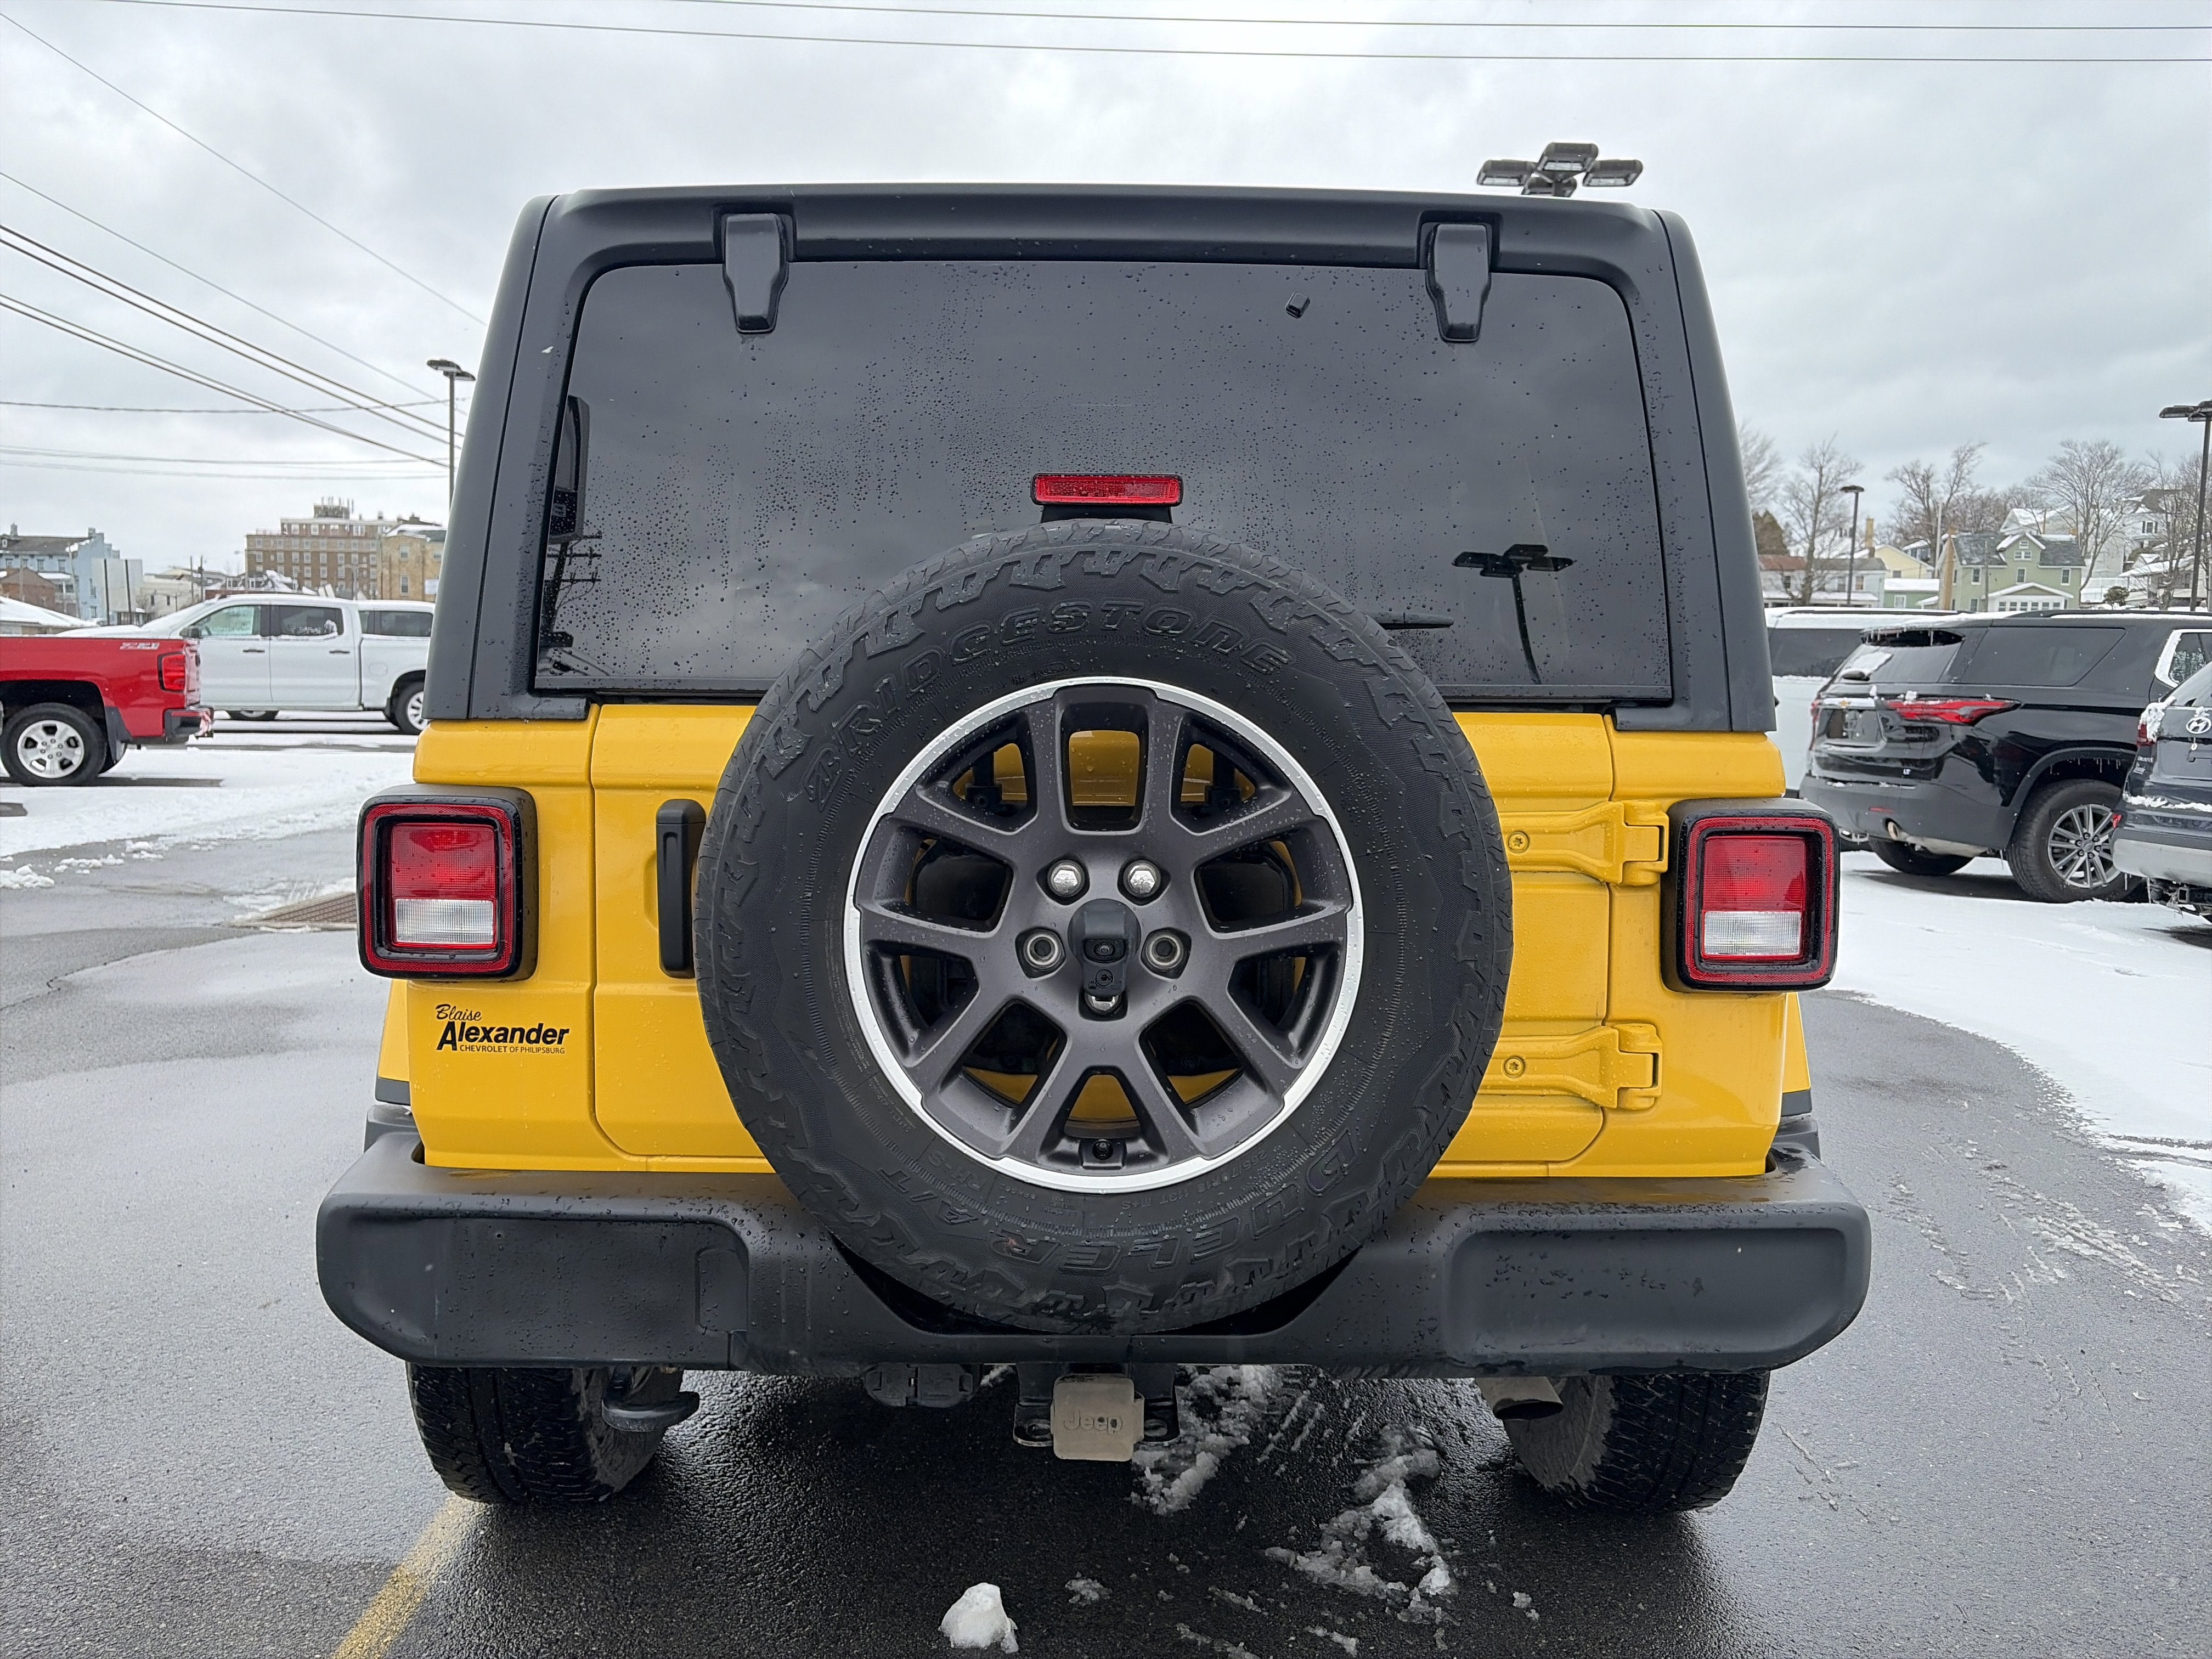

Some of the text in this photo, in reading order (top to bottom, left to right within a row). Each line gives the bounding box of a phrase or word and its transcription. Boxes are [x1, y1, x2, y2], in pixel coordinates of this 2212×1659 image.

[803, 600, 1295, 812] BRIDGESTONE
[436, 1004, 482, 1021] Blaise
[436, 1021, 569, 1051] Alexander
[460, 1045, 507, 1053] CHEVROLET
[520, 1046, 565, 1054] PHILIPSBURG
[929, 1151, 981, 1192] RH-S
[877, 1127, 1361, 1271] DUELER A/T
[1064, 1410, 1123, 1435] Jeep
